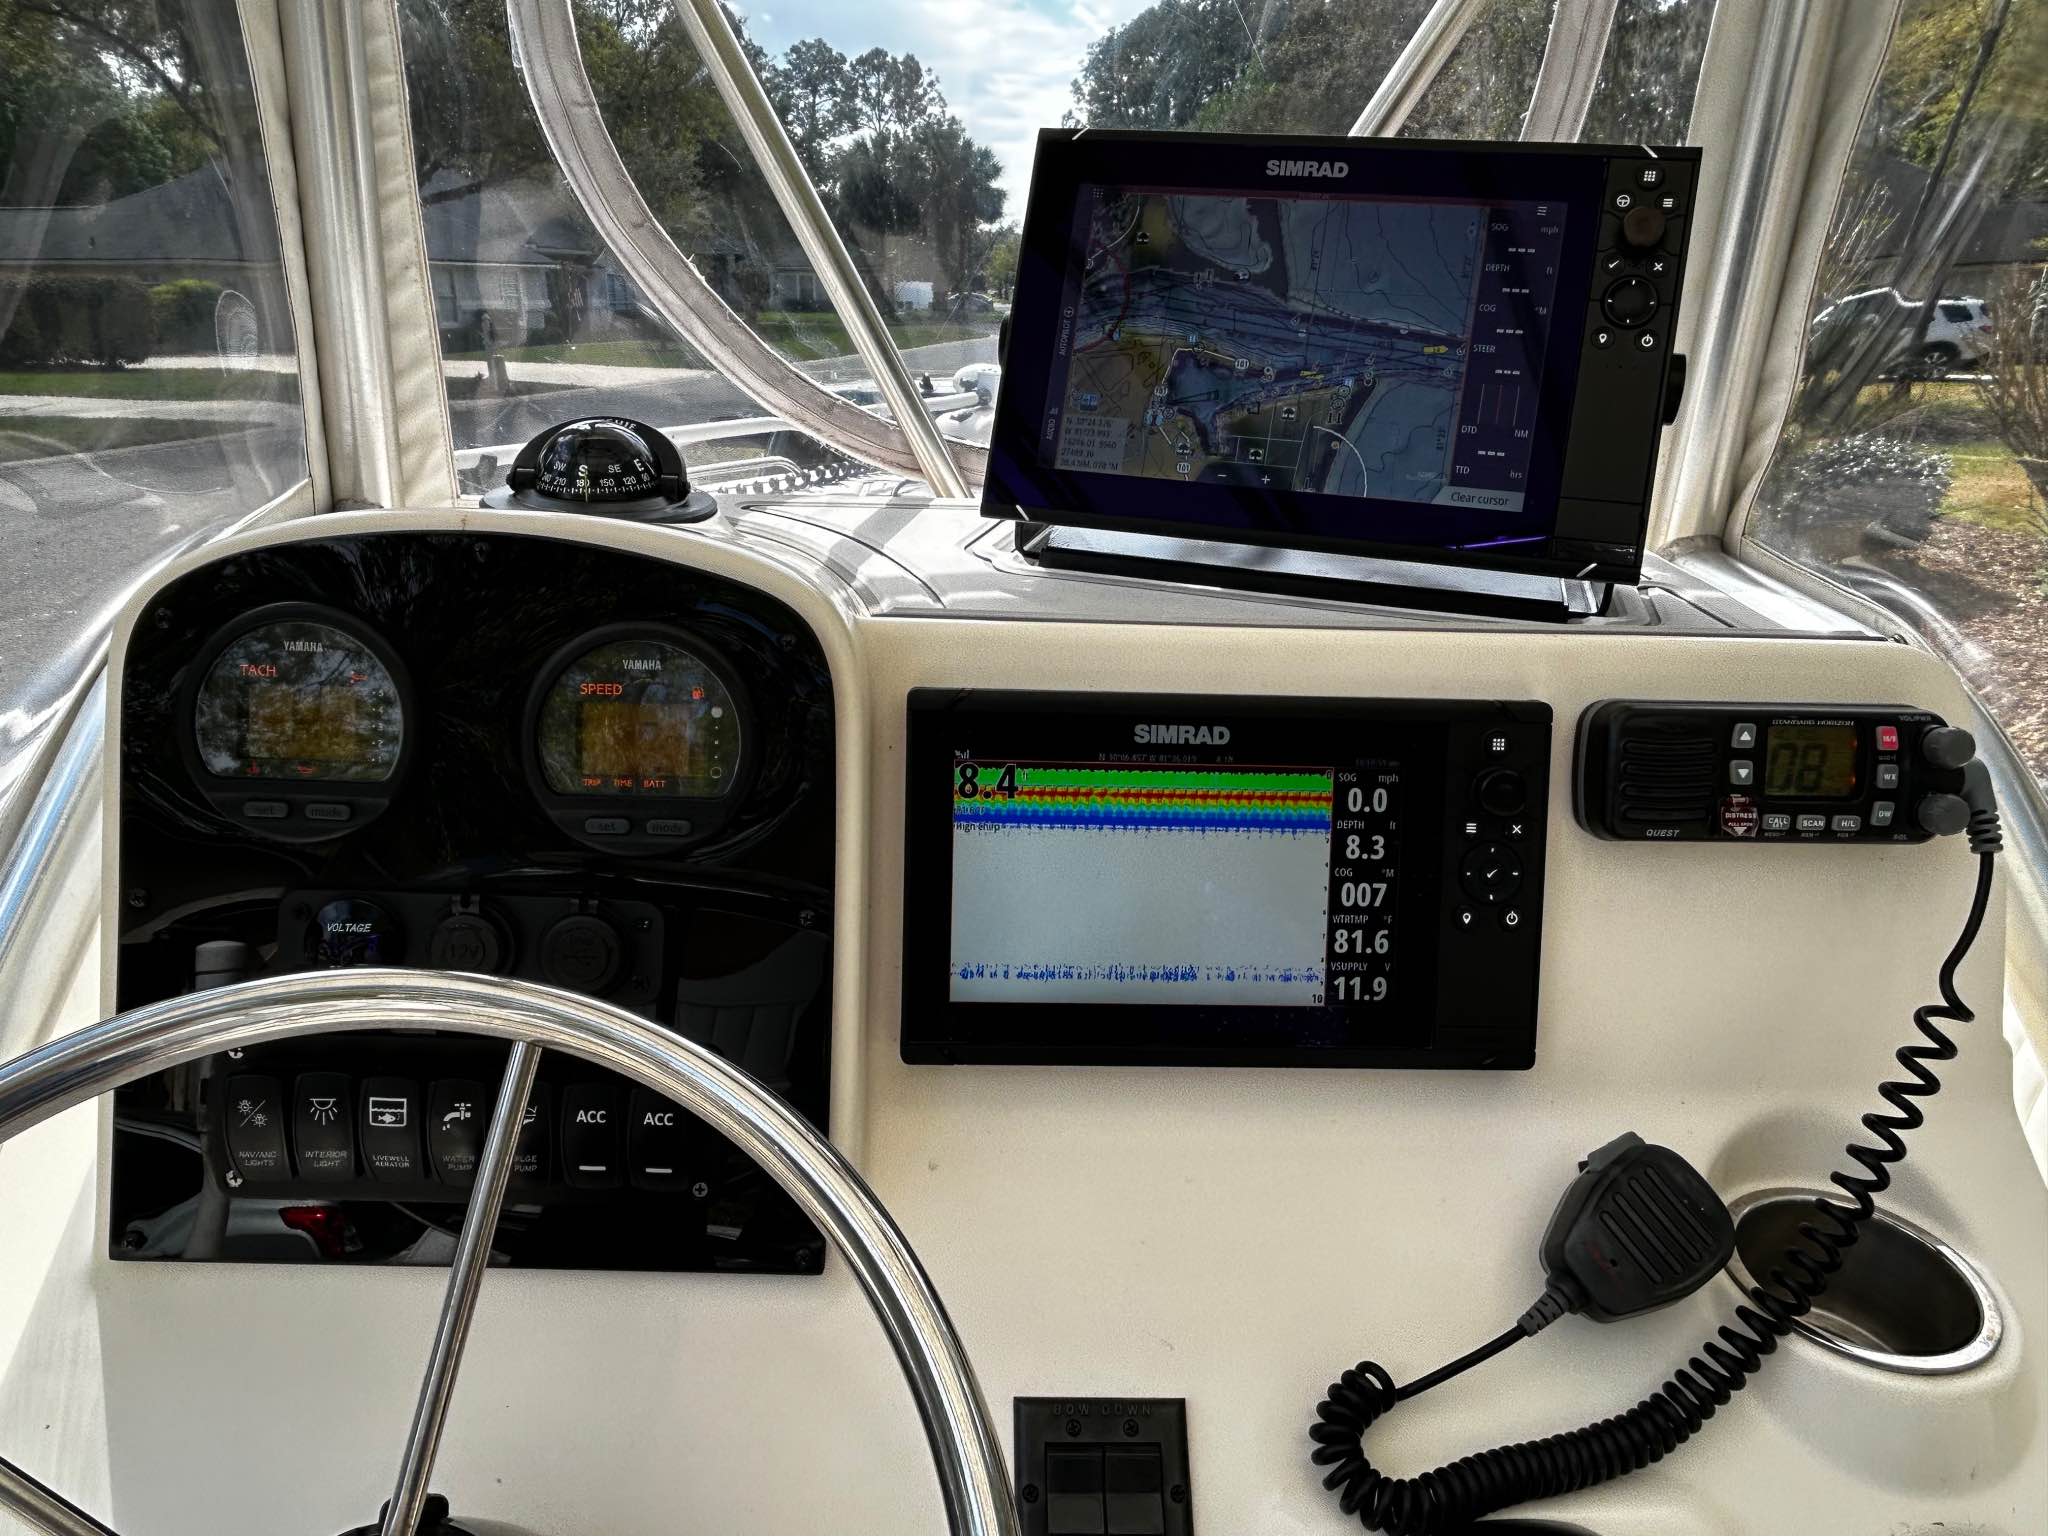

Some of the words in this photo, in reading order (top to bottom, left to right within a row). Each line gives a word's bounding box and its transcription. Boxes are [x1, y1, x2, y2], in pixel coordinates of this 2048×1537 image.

[1265, 160, 1350, 178] SIMRAD
[1489, 223, 1510, 233] SOG
[1541, 225, 1560, 236] mph
[1485, 263, 1511, 273] DEPTH
[1479, 303, 1497, 313] COG
[1473, 343, 1497, 354] STEER
[1461, 425, 1478, 435] DTD
[1514, 428, 1530, 439] NM
[553, 461, 567, 472] SW
[578, 464, 589, 478] S
[607, 464, 622, 474] SE
[633, 458, 645, 472] E
[1456, 465, 1471, 475] TTD
[1509, 469, 1523, 480] hrs
[553, 477, 567, 486] 210
[600, 478, 615, 487] 150
[623, 475, 637, 485] 120
[1451, 491, 1476, 504] Clear
[1477, 494, 1510, 506] cursor
[283, 640, 325, 652] YAMAHA
[623, 658, 662, 671] YAMAHA
[240, 664, 277, 677] TACH
[579, 682, 624, 696] SPEED
[1816, 719, 1855, 727] HORIZON
[1133, 724, 1231, 745] SIMRAD
[583, 778, 601, 787] TRIP
[642, 779, 666, 788] BATT
[958, 762, 1019, 800] 8.4
[1338, 773, 1358, 783] SOG
[1378, 773, 1399, 784] mph
[1347, 787, 1388, 813] 0.0
[1725, 812, 1757, 820] DISTRESS
[1337, 820, 1365, 830] DEPTH
[1389, 820, 1397, 830] ft
[1646, 829, 1680, 838] QUEST
[1346, 834, 1386, 860] 8.3
[1334, 867, 1353, 877] COG
[1340, 881, 1388, 908] 007
[1332, 914, 1369, 924] WTRTMP
[327, 923, 372, 933] VOLTAGE
[1333, 928, 1390, 955] 81.6
[1330, 961, 1369, 972] VSUPPLY
[1384, 962, 1392, 972] V
[1333, 976, 1388, 1002] 11.9
[1311, 993, 1323, 1004] 10
[575, 1109, 608, 1124] ACC
[643, 1112, 675, 1126] ACC
[239, 1150, 277, 1159] NAV/ANC
[305, 1150, 348, 1159] INTERIOR
[372, 1154, 410, 1162] LIVEWELL
[442, 1154, 476, 1163] WATER
[244, 1159, 275, 1167] LIGHTS
[313, 1159, 341, 1168] LIGHT
[375, 1161, 411, 1169] AERATOR
[447, 1163, 474, 1171] PUMP
[513, 1164, 538, 1173] PUMP
[1053, 1403, 1090, 1416] BOW
[1102, 1403, 1152, 1416] DOWN
